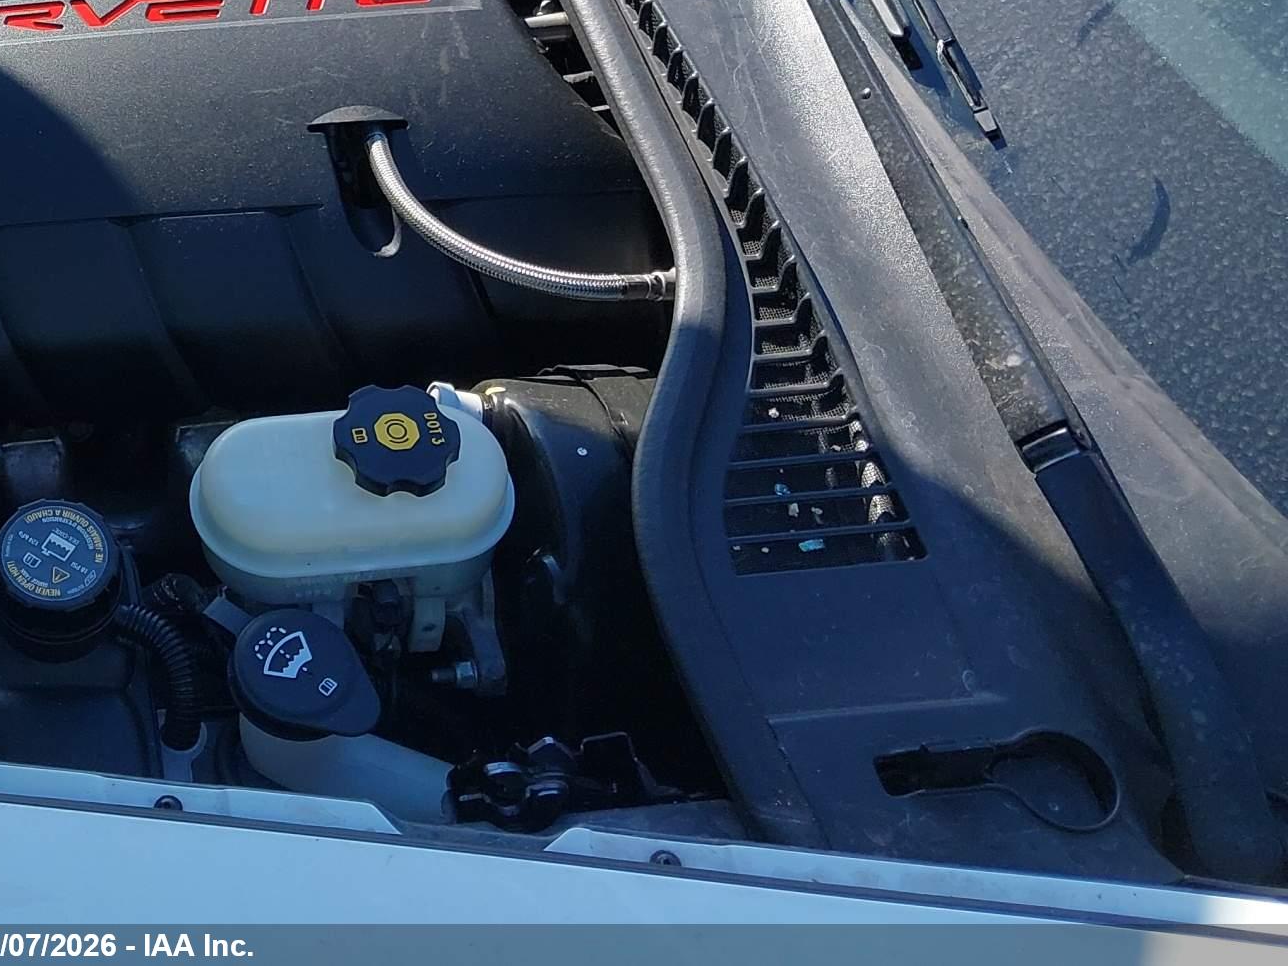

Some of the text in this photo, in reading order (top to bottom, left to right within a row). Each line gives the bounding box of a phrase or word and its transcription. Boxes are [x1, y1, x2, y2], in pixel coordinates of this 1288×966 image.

[423, 412, 445, 445] DOT 3
[63, 510, 89, 527] OUVRIR
[87, 525, 103, 551] JAMAIS
[95, 552, 103, 563] NE
[16, 576, 34, 590] OPEN
[35, 586, 61, 597] NEVER
